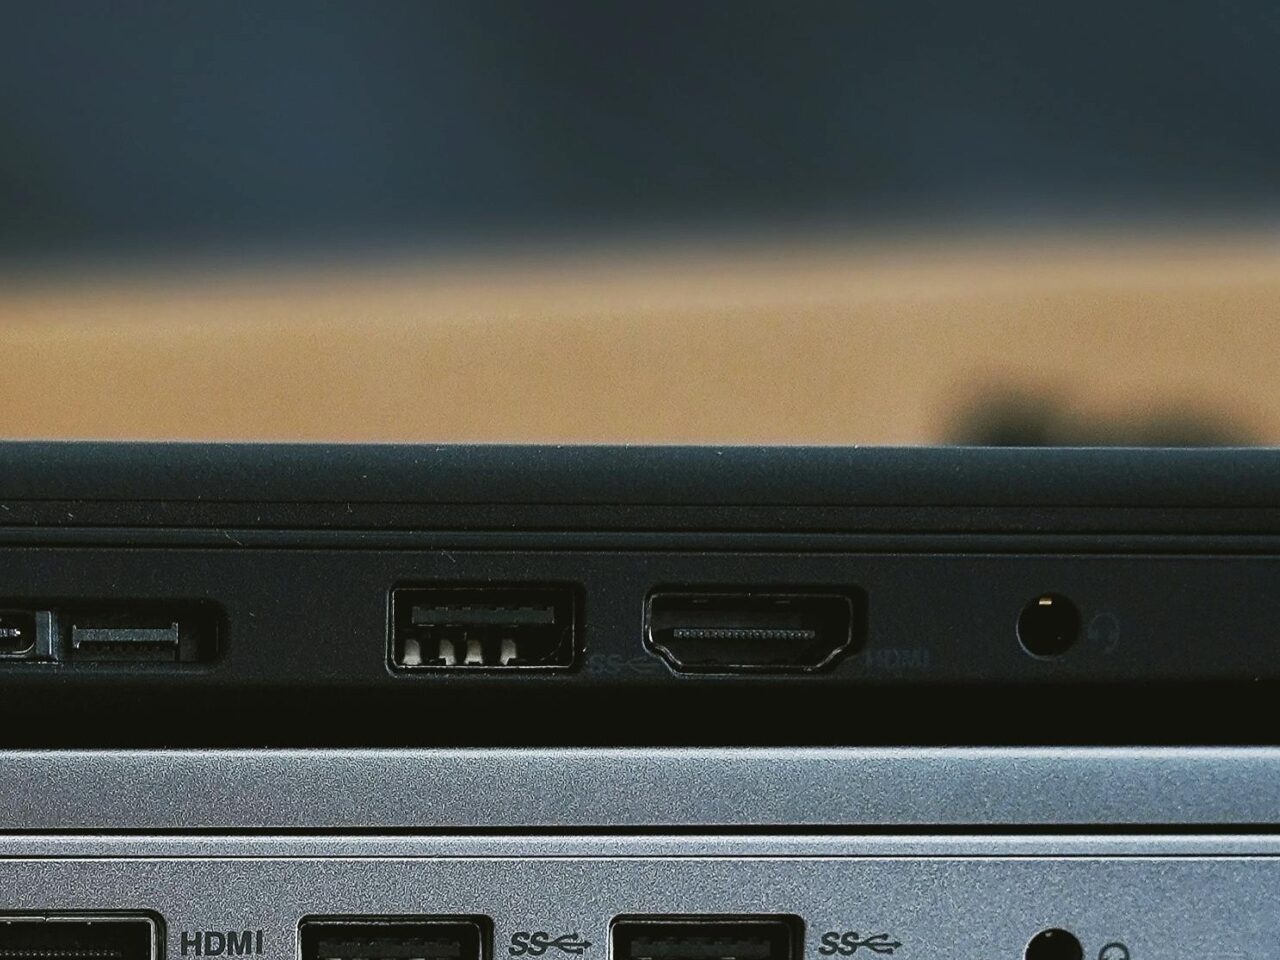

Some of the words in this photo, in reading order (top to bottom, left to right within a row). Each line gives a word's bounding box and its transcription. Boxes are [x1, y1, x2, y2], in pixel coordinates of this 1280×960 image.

[180, 930, 263, 956] HDMI
[508, 931, 549, 956] SS
[818, 931, 860, 956] SS
